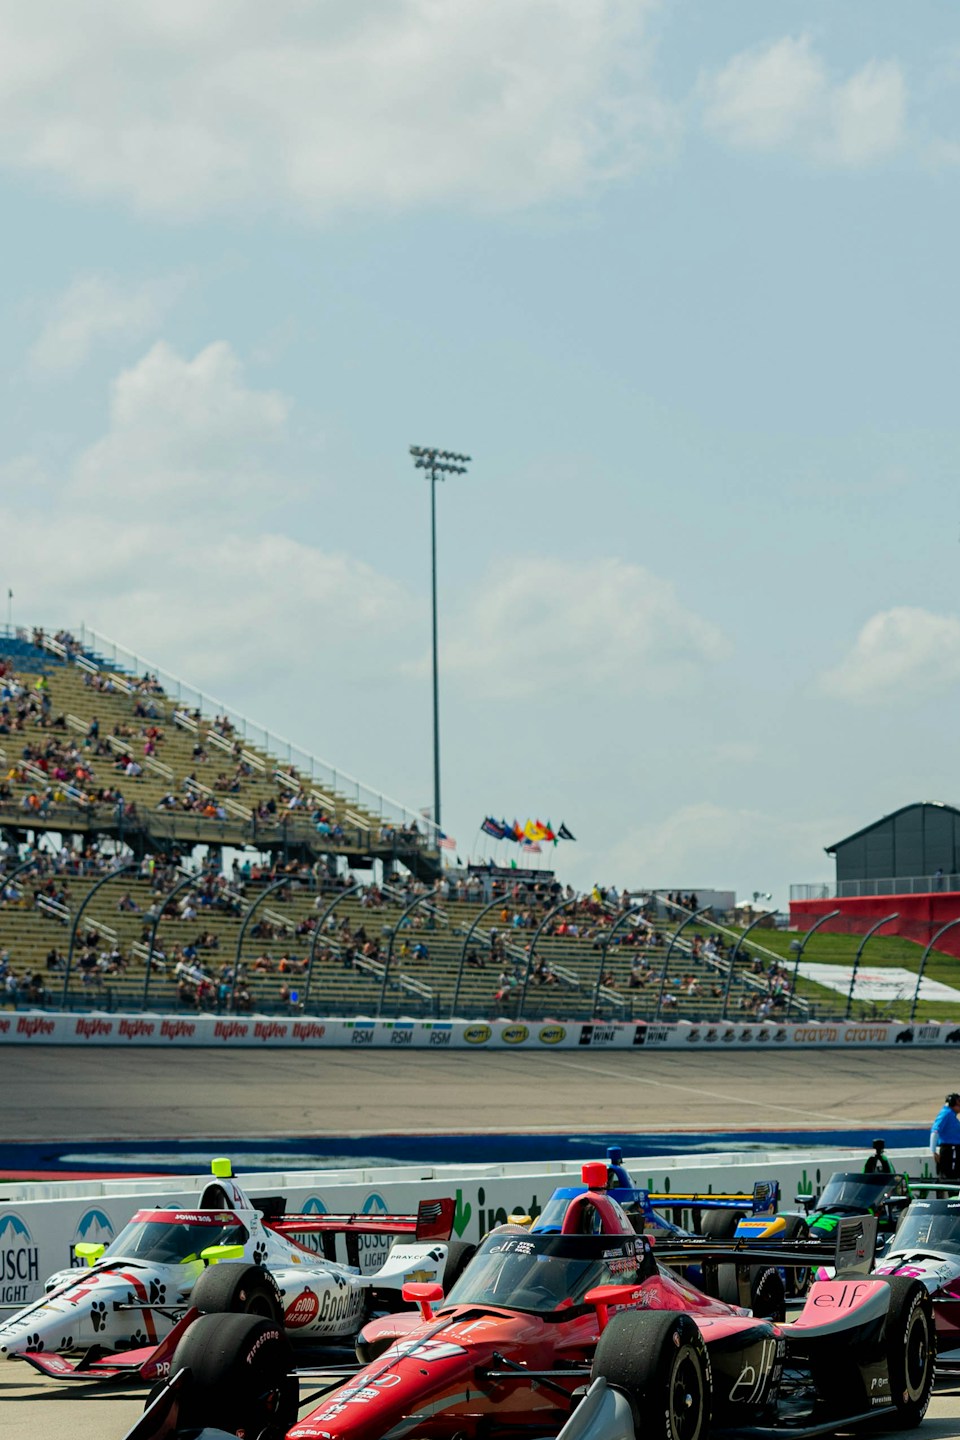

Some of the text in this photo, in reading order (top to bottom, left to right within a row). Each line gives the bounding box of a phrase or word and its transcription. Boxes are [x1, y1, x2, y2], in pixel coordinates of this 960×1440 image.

[352, 1030, 373, 1043] RSM
[390, 1031, 412, 1044] RSM
[430, 1032, 450, 1044] RSM
[0, 1248, 39, 1281] SCH
[364, 1252, 388, 1267] LIGHT
[0, 1285, 28, 1303] IGHT
[294, 1298, 315, 1312] GOOD
[285, 1313, 312, 1322] HEART
[246, 1330, 279, 1364] Firestone
